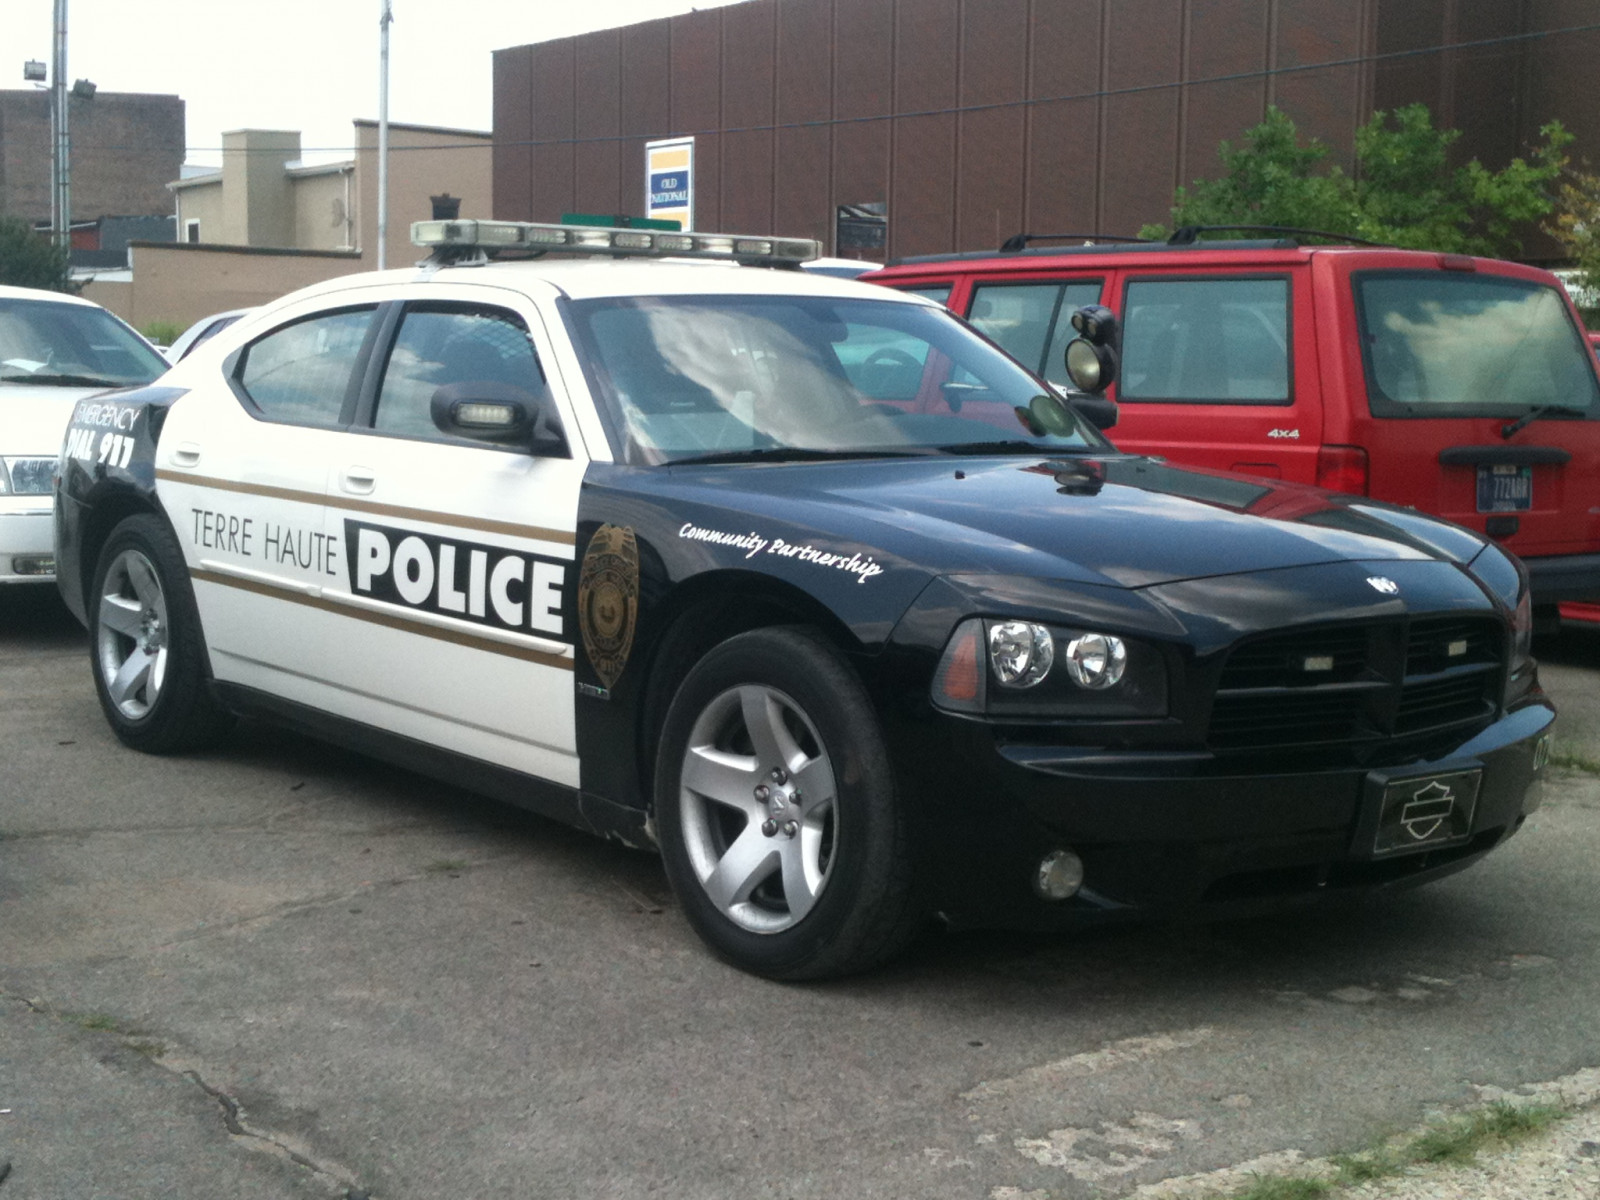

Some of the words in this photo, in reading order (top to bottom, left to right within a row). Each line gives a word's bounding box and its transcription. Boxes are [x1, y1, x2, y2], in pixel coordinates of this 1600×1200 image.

[661, 178, 678, 189] OLD
[65, 427, 97, 461] DIAL
[97, 431, 136, 470] 911
[1267, 428, 1300, 440] 4x4
[192, 508, 253, 556] TERRE
[264, 522, 338, 576] HAUTE
[356, 527, 566, 636] POLICE
[678, 522, 769, 560] Community
[767, 537, 885, 584] Partnership
